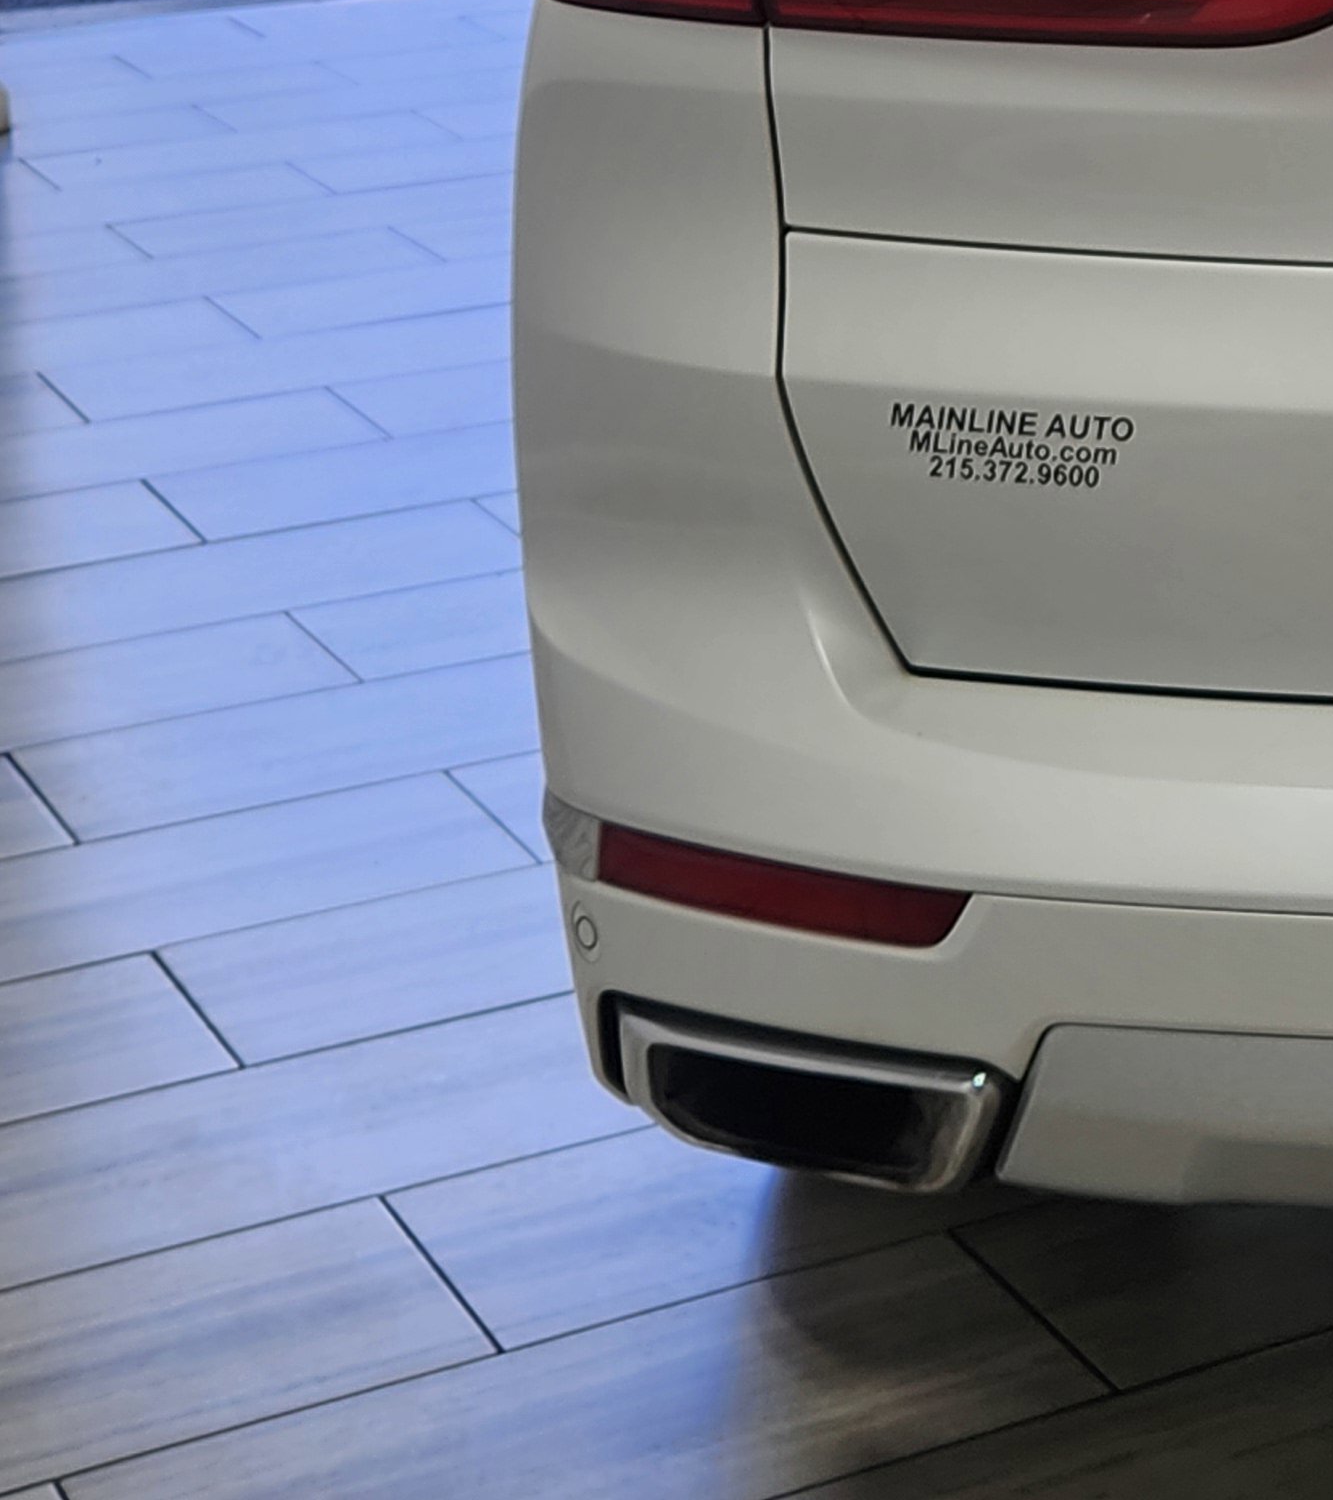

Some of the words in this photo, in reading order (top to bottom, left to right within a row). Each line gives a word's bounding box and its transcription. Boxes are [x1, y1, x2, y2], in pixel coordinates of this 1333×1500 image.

[890, 402, 1038, 436] MAINLINE
[1045, 414, 1134, 442] AUTO
[909, 430, 1118, 466] MLineAuto.com
[929, 455, 1101, 488] 215.372.9600
